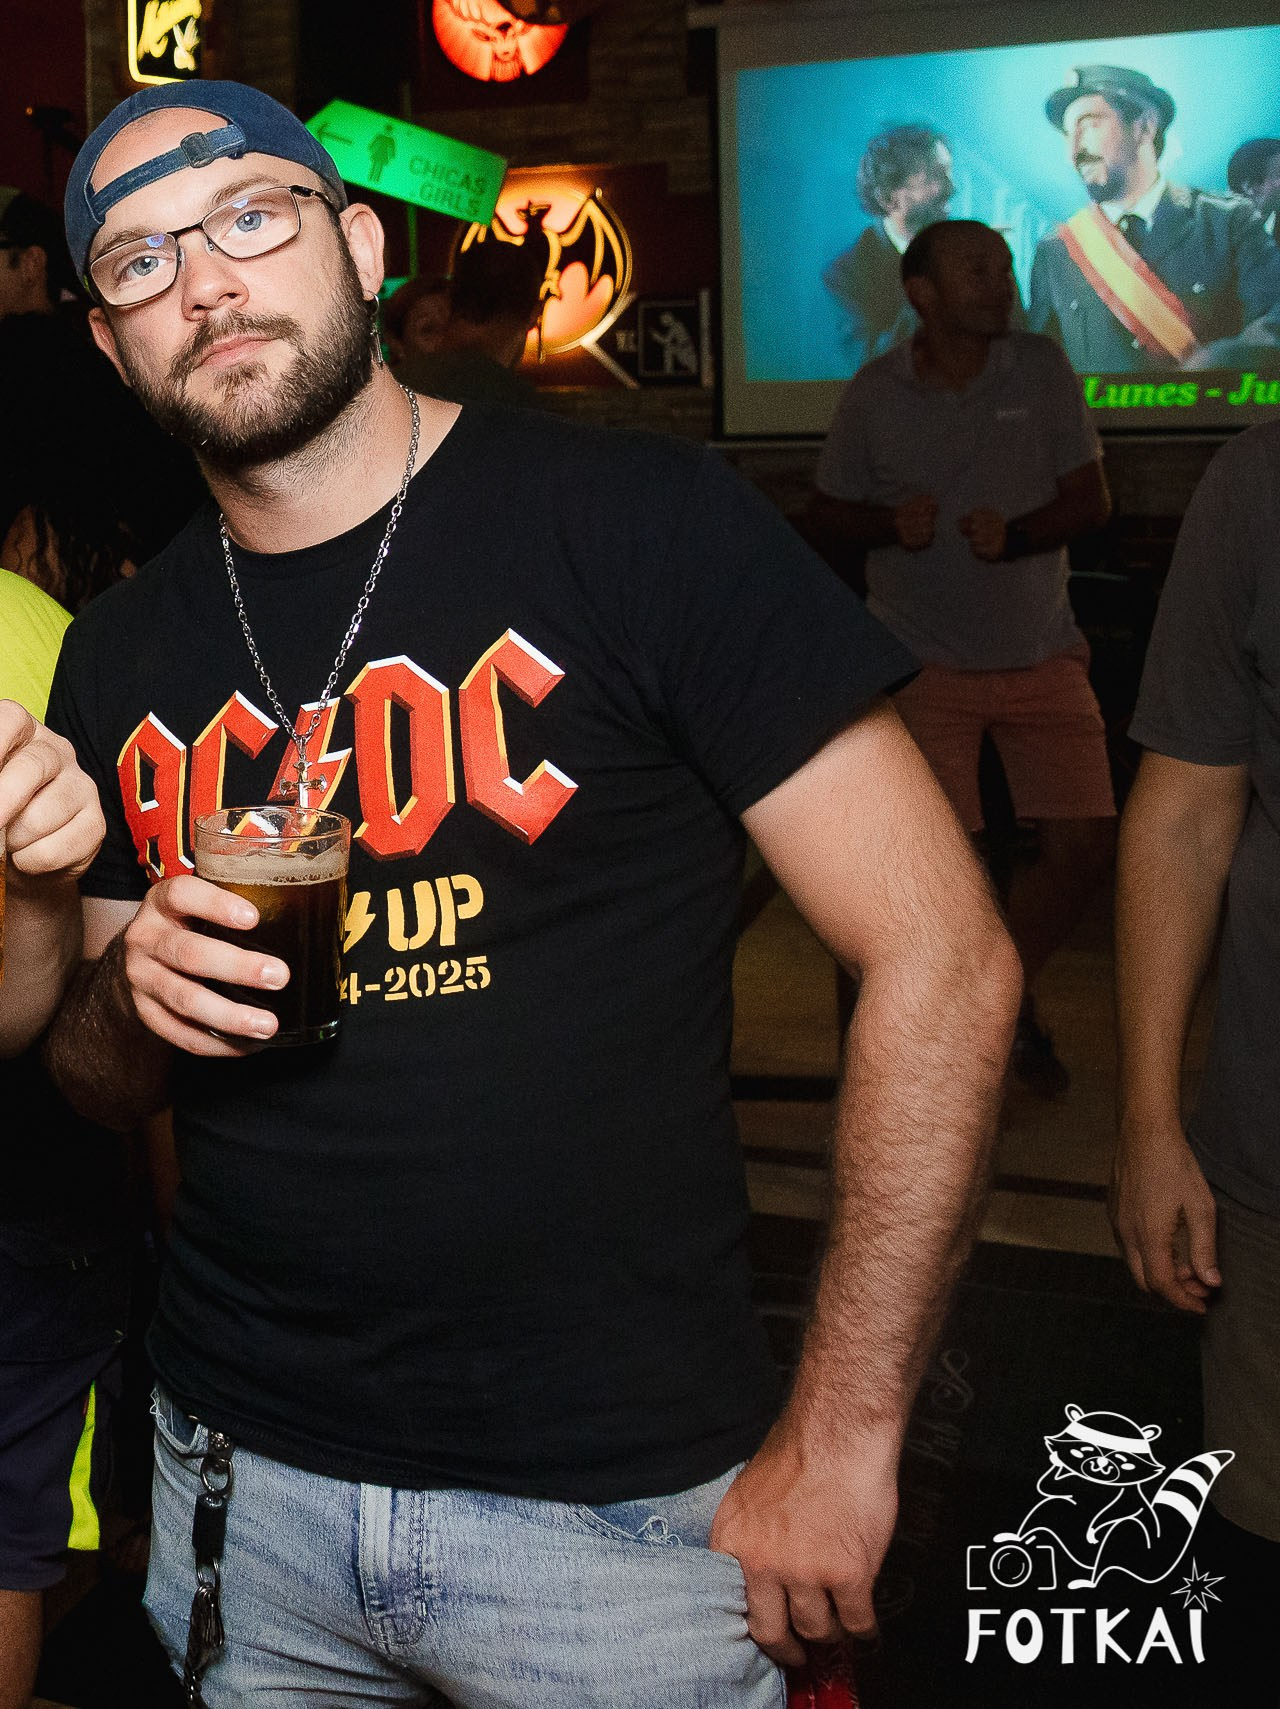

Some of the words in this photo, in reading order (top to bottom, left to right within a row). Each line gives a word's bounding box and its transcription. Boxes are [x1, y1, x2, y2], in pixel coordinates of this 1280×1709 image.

[408, 155, 486, 196] CHICAS
[419, 181, 479, 216] GIRLS
[1084, 376, 1199, 409] Lunes
[387, 873, 485, 952] UP
[340, 955, 491, 1005] 4-2025
